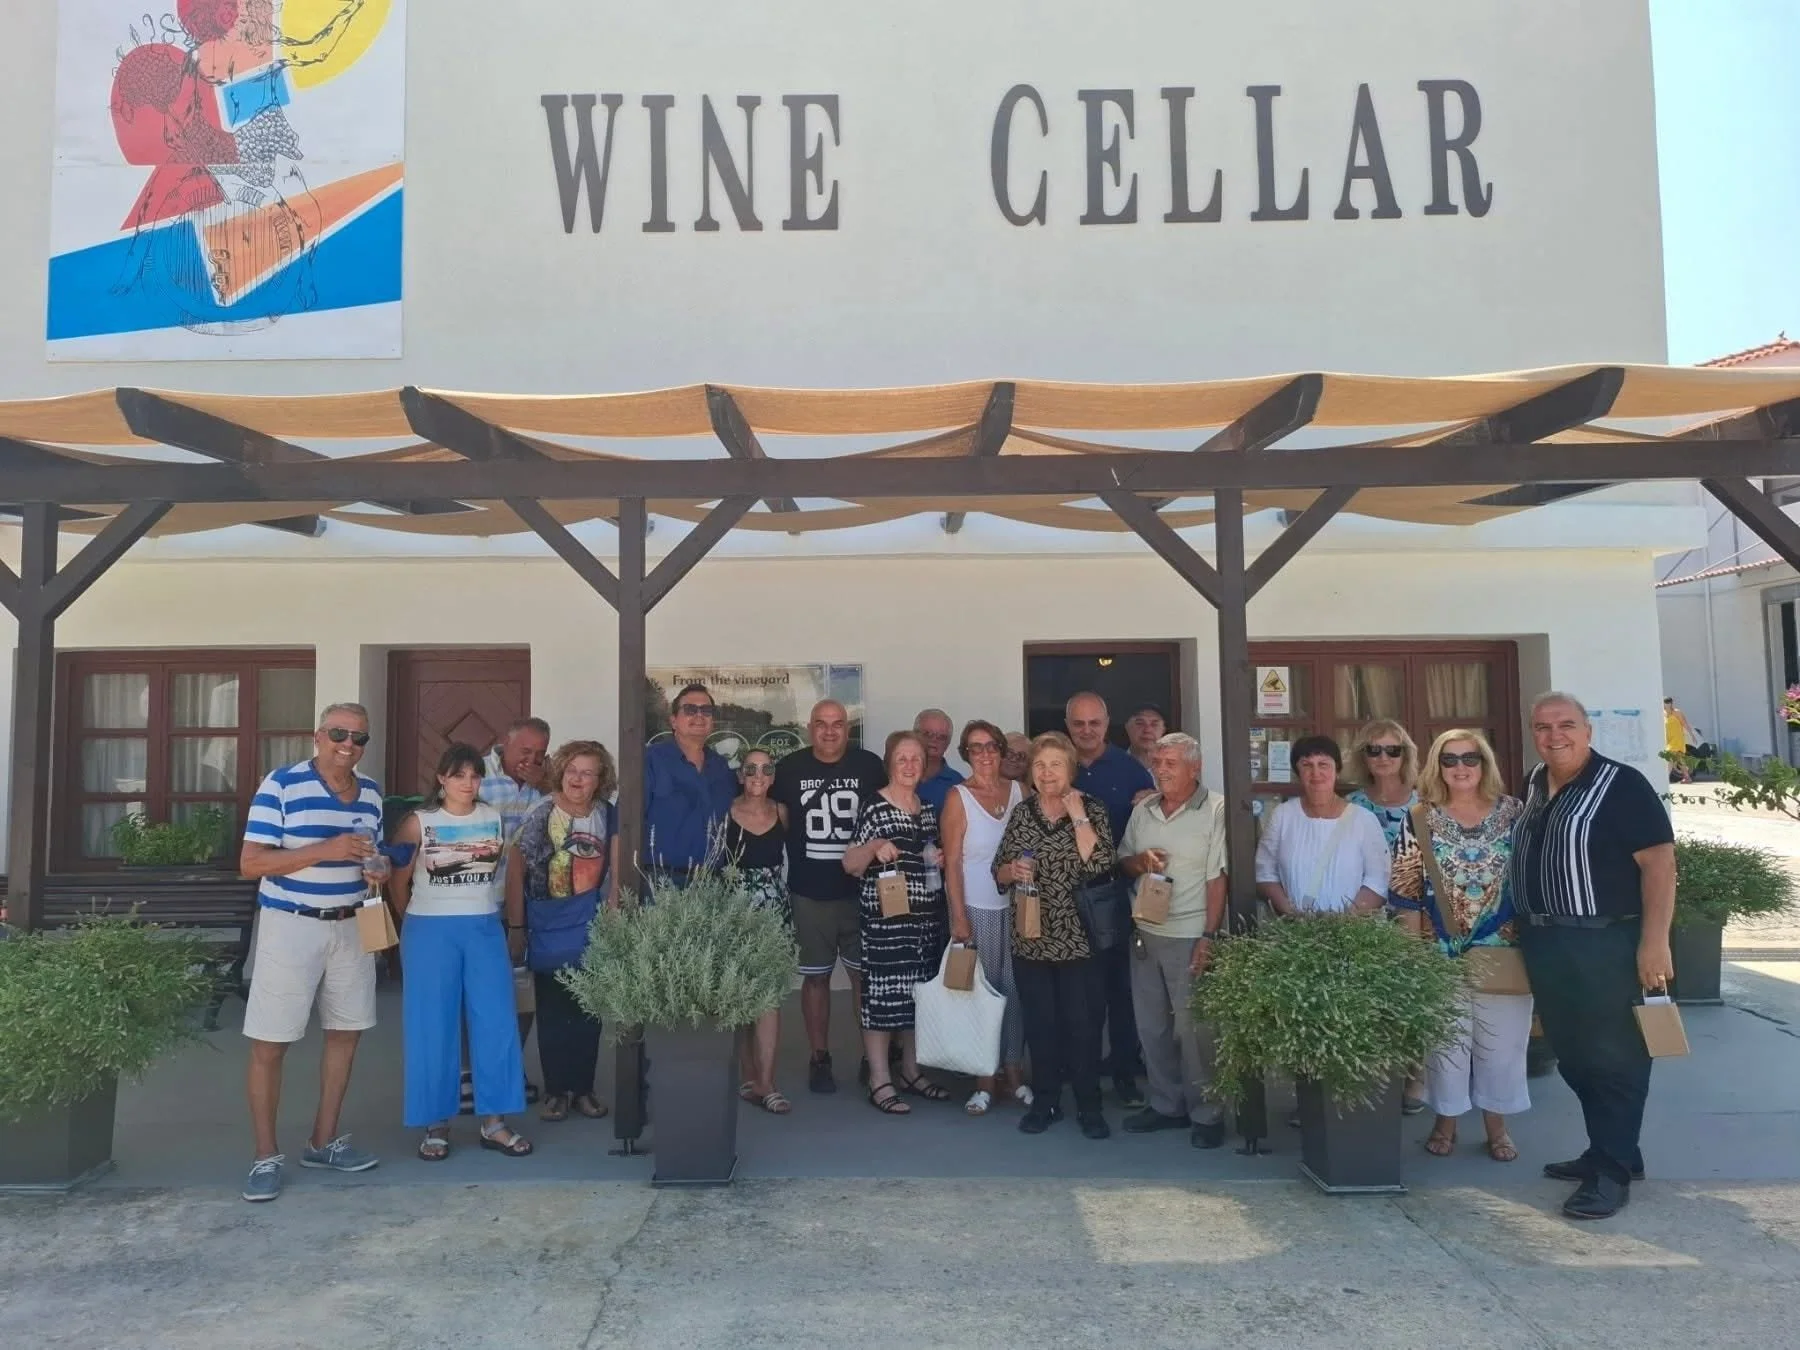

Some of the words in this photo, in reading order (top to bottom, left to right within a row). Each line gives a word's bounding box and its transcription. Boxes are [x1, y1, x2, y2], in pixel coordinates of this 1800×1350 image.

[541, 94, 840, 233] WINE
[991, 80, 1492, 226] CELLAR
[672, 675, 706, 686] From
[710, 673, 733, 685] the
[735, 673, 790, 687] vineyard
[800, 778, 859, 790] BROLYN
[432, 875, 455, 884] JUST
[459, 873, 480, 883] YOU
